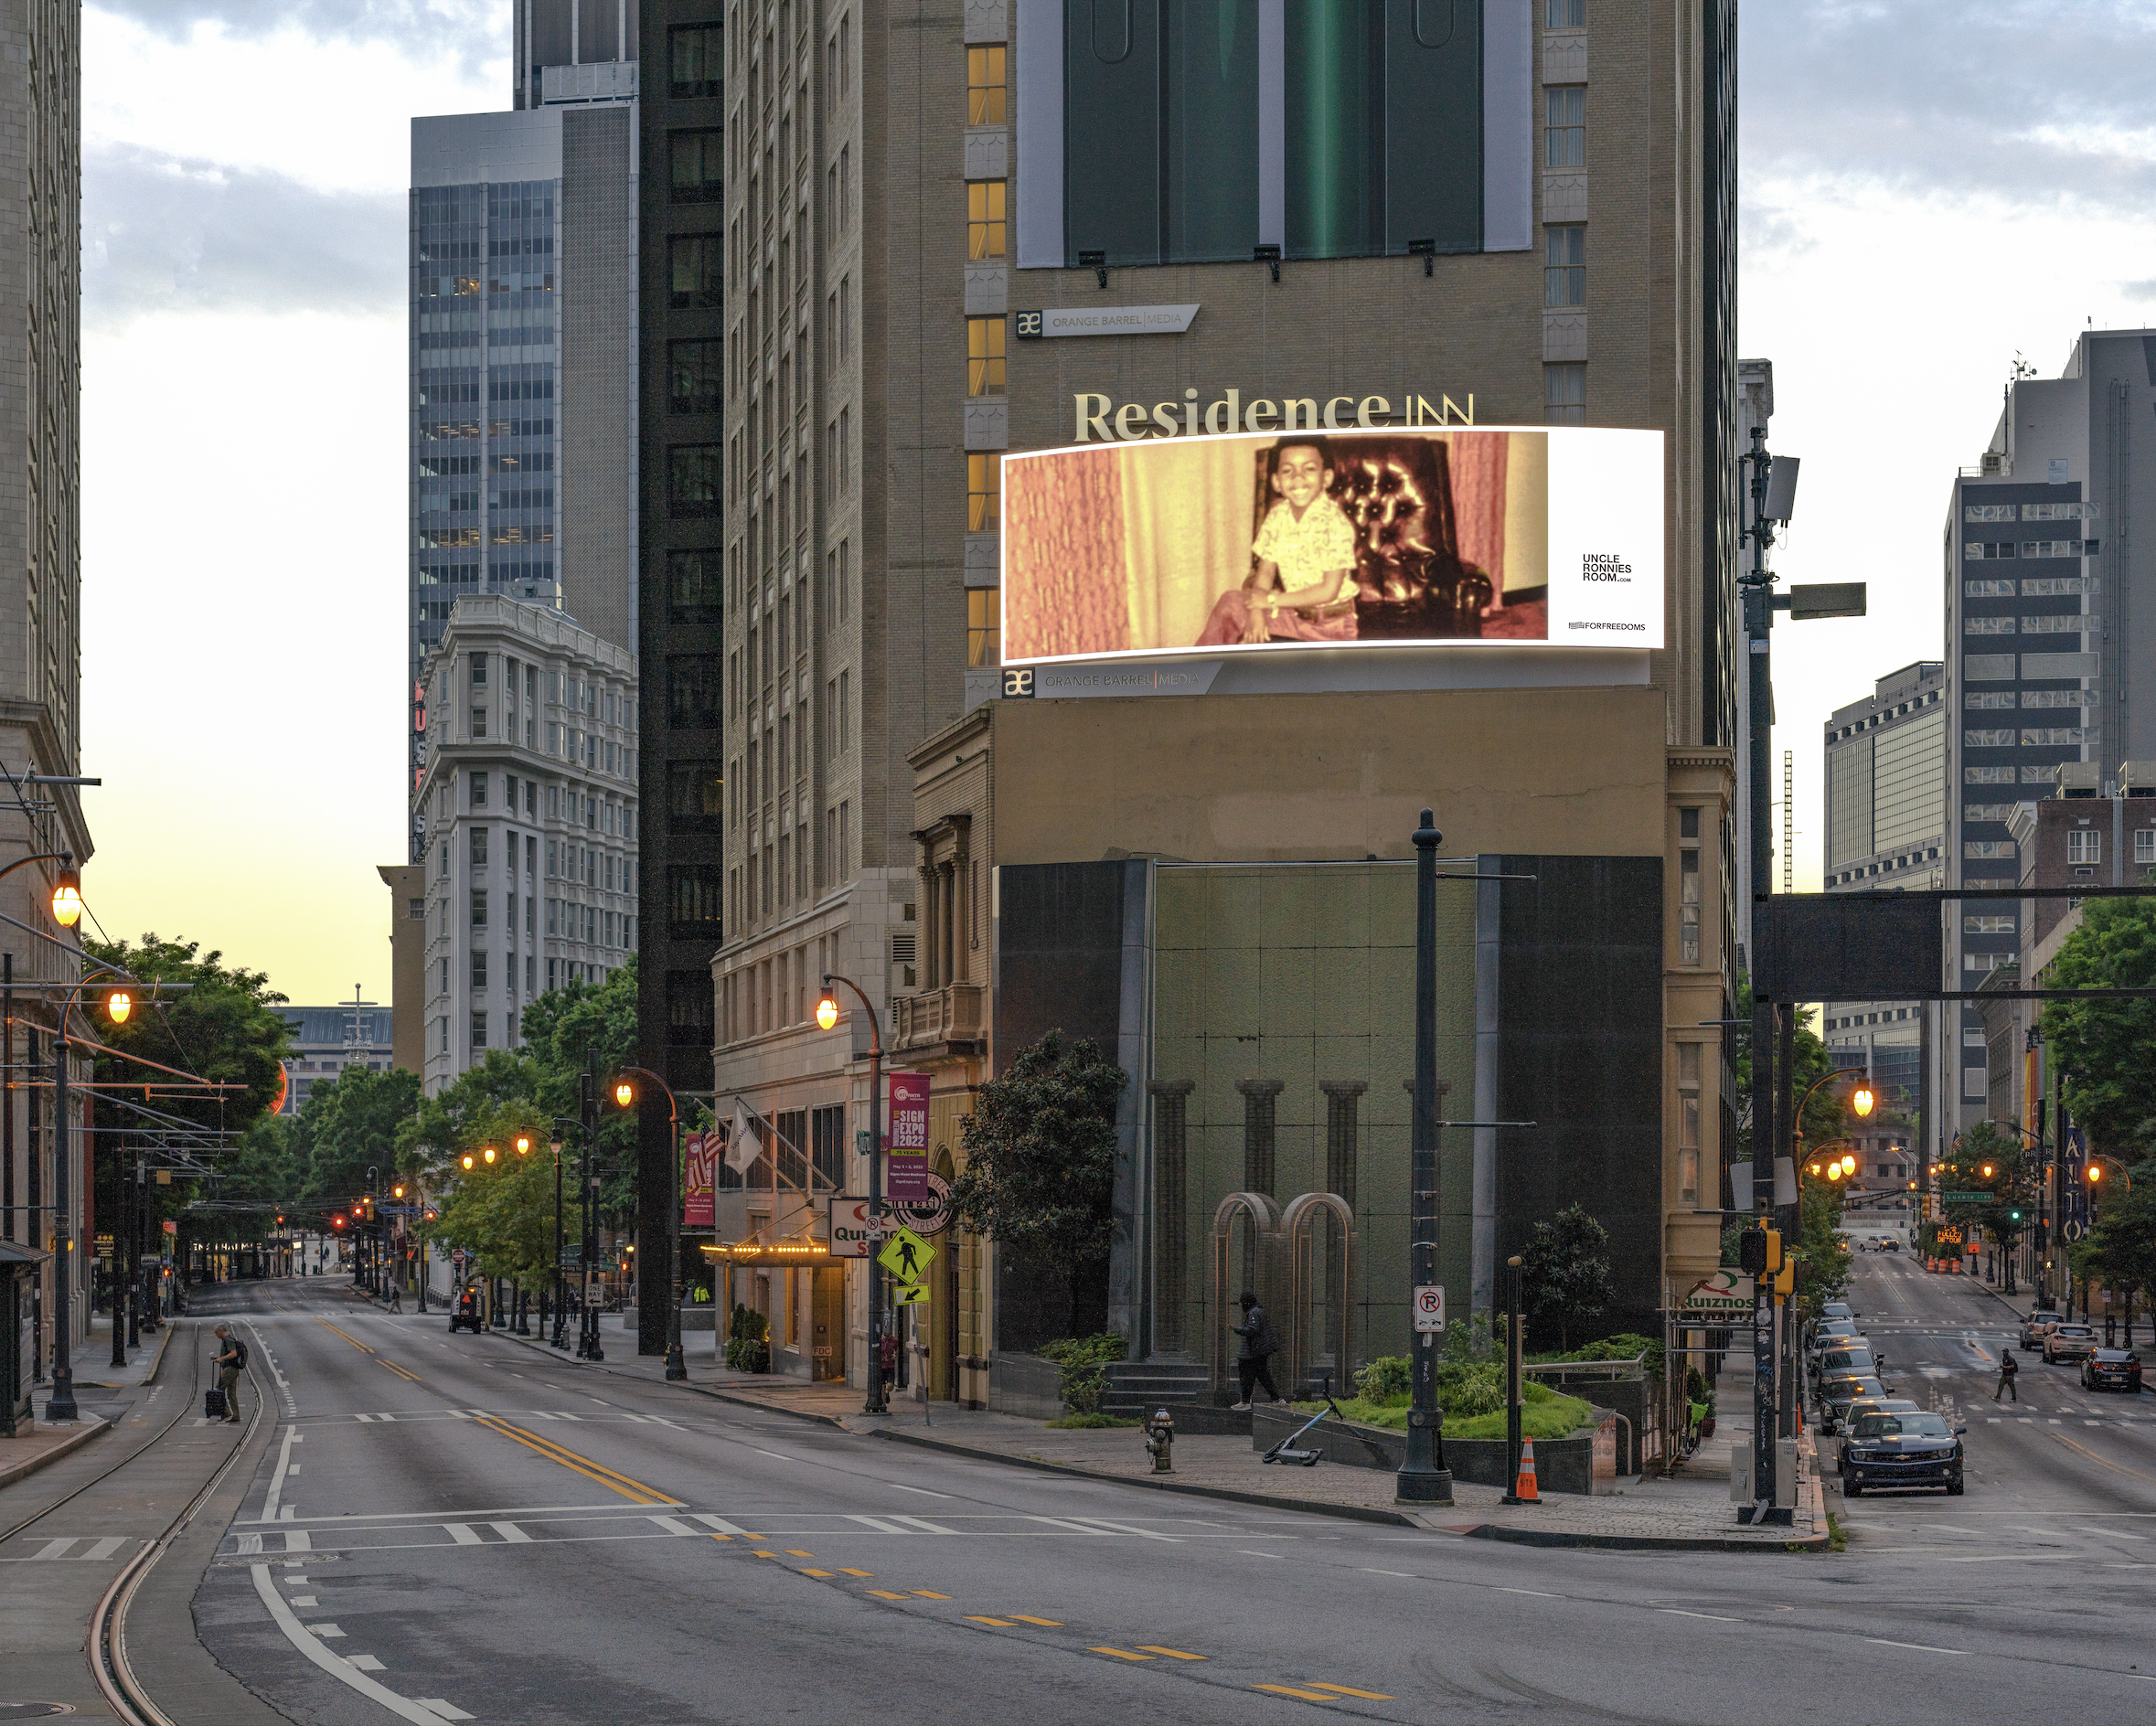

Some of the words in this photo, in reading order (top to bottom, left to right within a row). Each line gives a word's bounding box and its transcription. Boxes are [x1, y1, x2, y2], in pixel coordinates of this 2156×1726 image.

[1052, 317, 1098, 327] ORANGE
[1102, 315, 1141, 325] BARREL
[1147, 314, 1181, 324] MEDIA
[1073, 388, 1391, 442] Residence
[1405, 393, 1474, 427] INN
[1583, 553, 1620, 563] UNCLE
[1583, 563, 1632, 573] RONNIES
[1045, 676, 1100, 687] ORANGE
[1105, 674, 1152, 686] BARREL
[1158, 673, 1201, 685] MEDIA
[900, 1110, 924, 1123] SIGN
[900, 1123, 924, 1135] EXPO
[899, 1135, 924, 1147] 2022
[910, 1218, 940, 1231] STREET
[834, 1227, 898, 1241] Quino
[813, 1348, 831, 1356] FDC
[1521, 1479, 1533, 1487] STS
